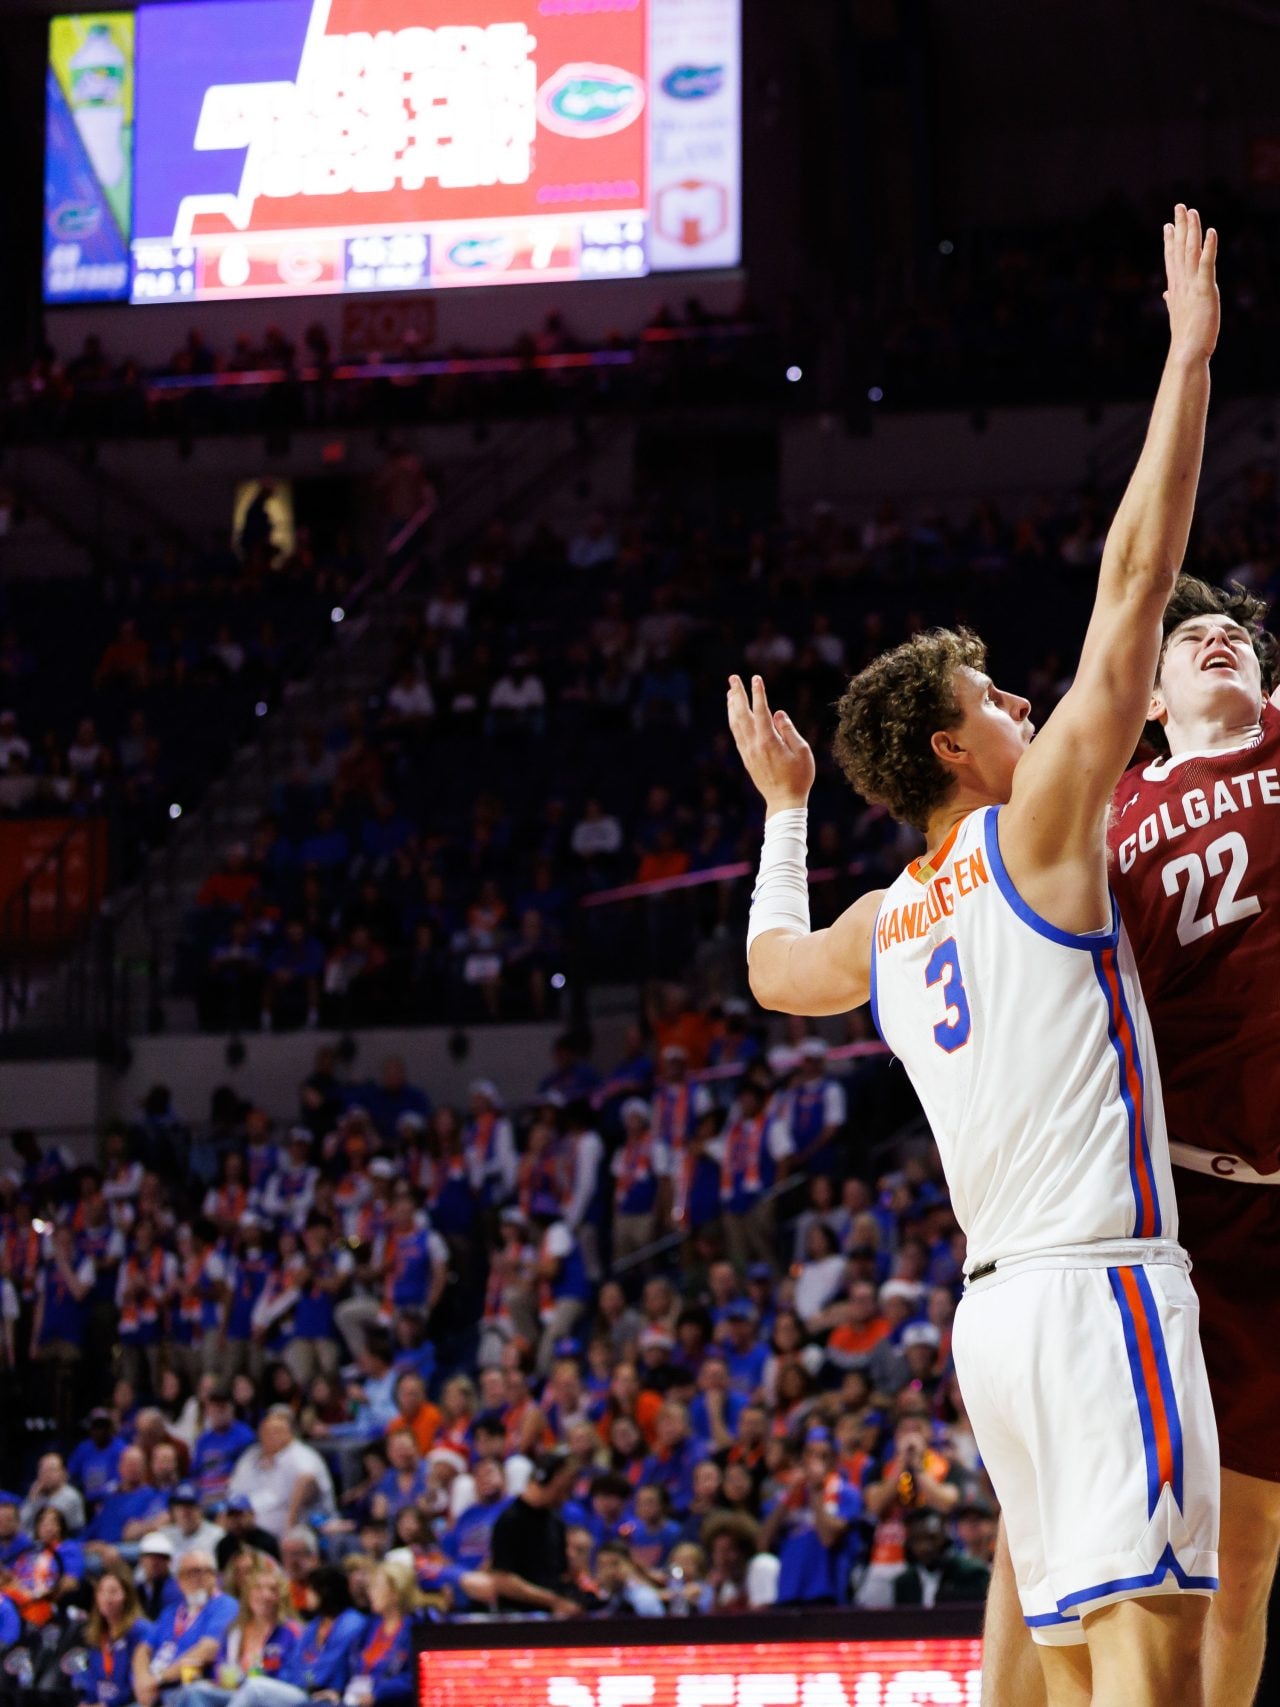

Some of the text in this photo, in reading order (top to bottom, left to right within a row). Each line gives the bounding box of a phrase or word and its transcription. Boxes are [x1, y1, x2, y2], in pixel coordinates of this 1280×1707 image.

[1161, 831, 1262, 947] 22
[924, 935, 972, 1054] 3
[1211, 1155, 1239, 1176] C
